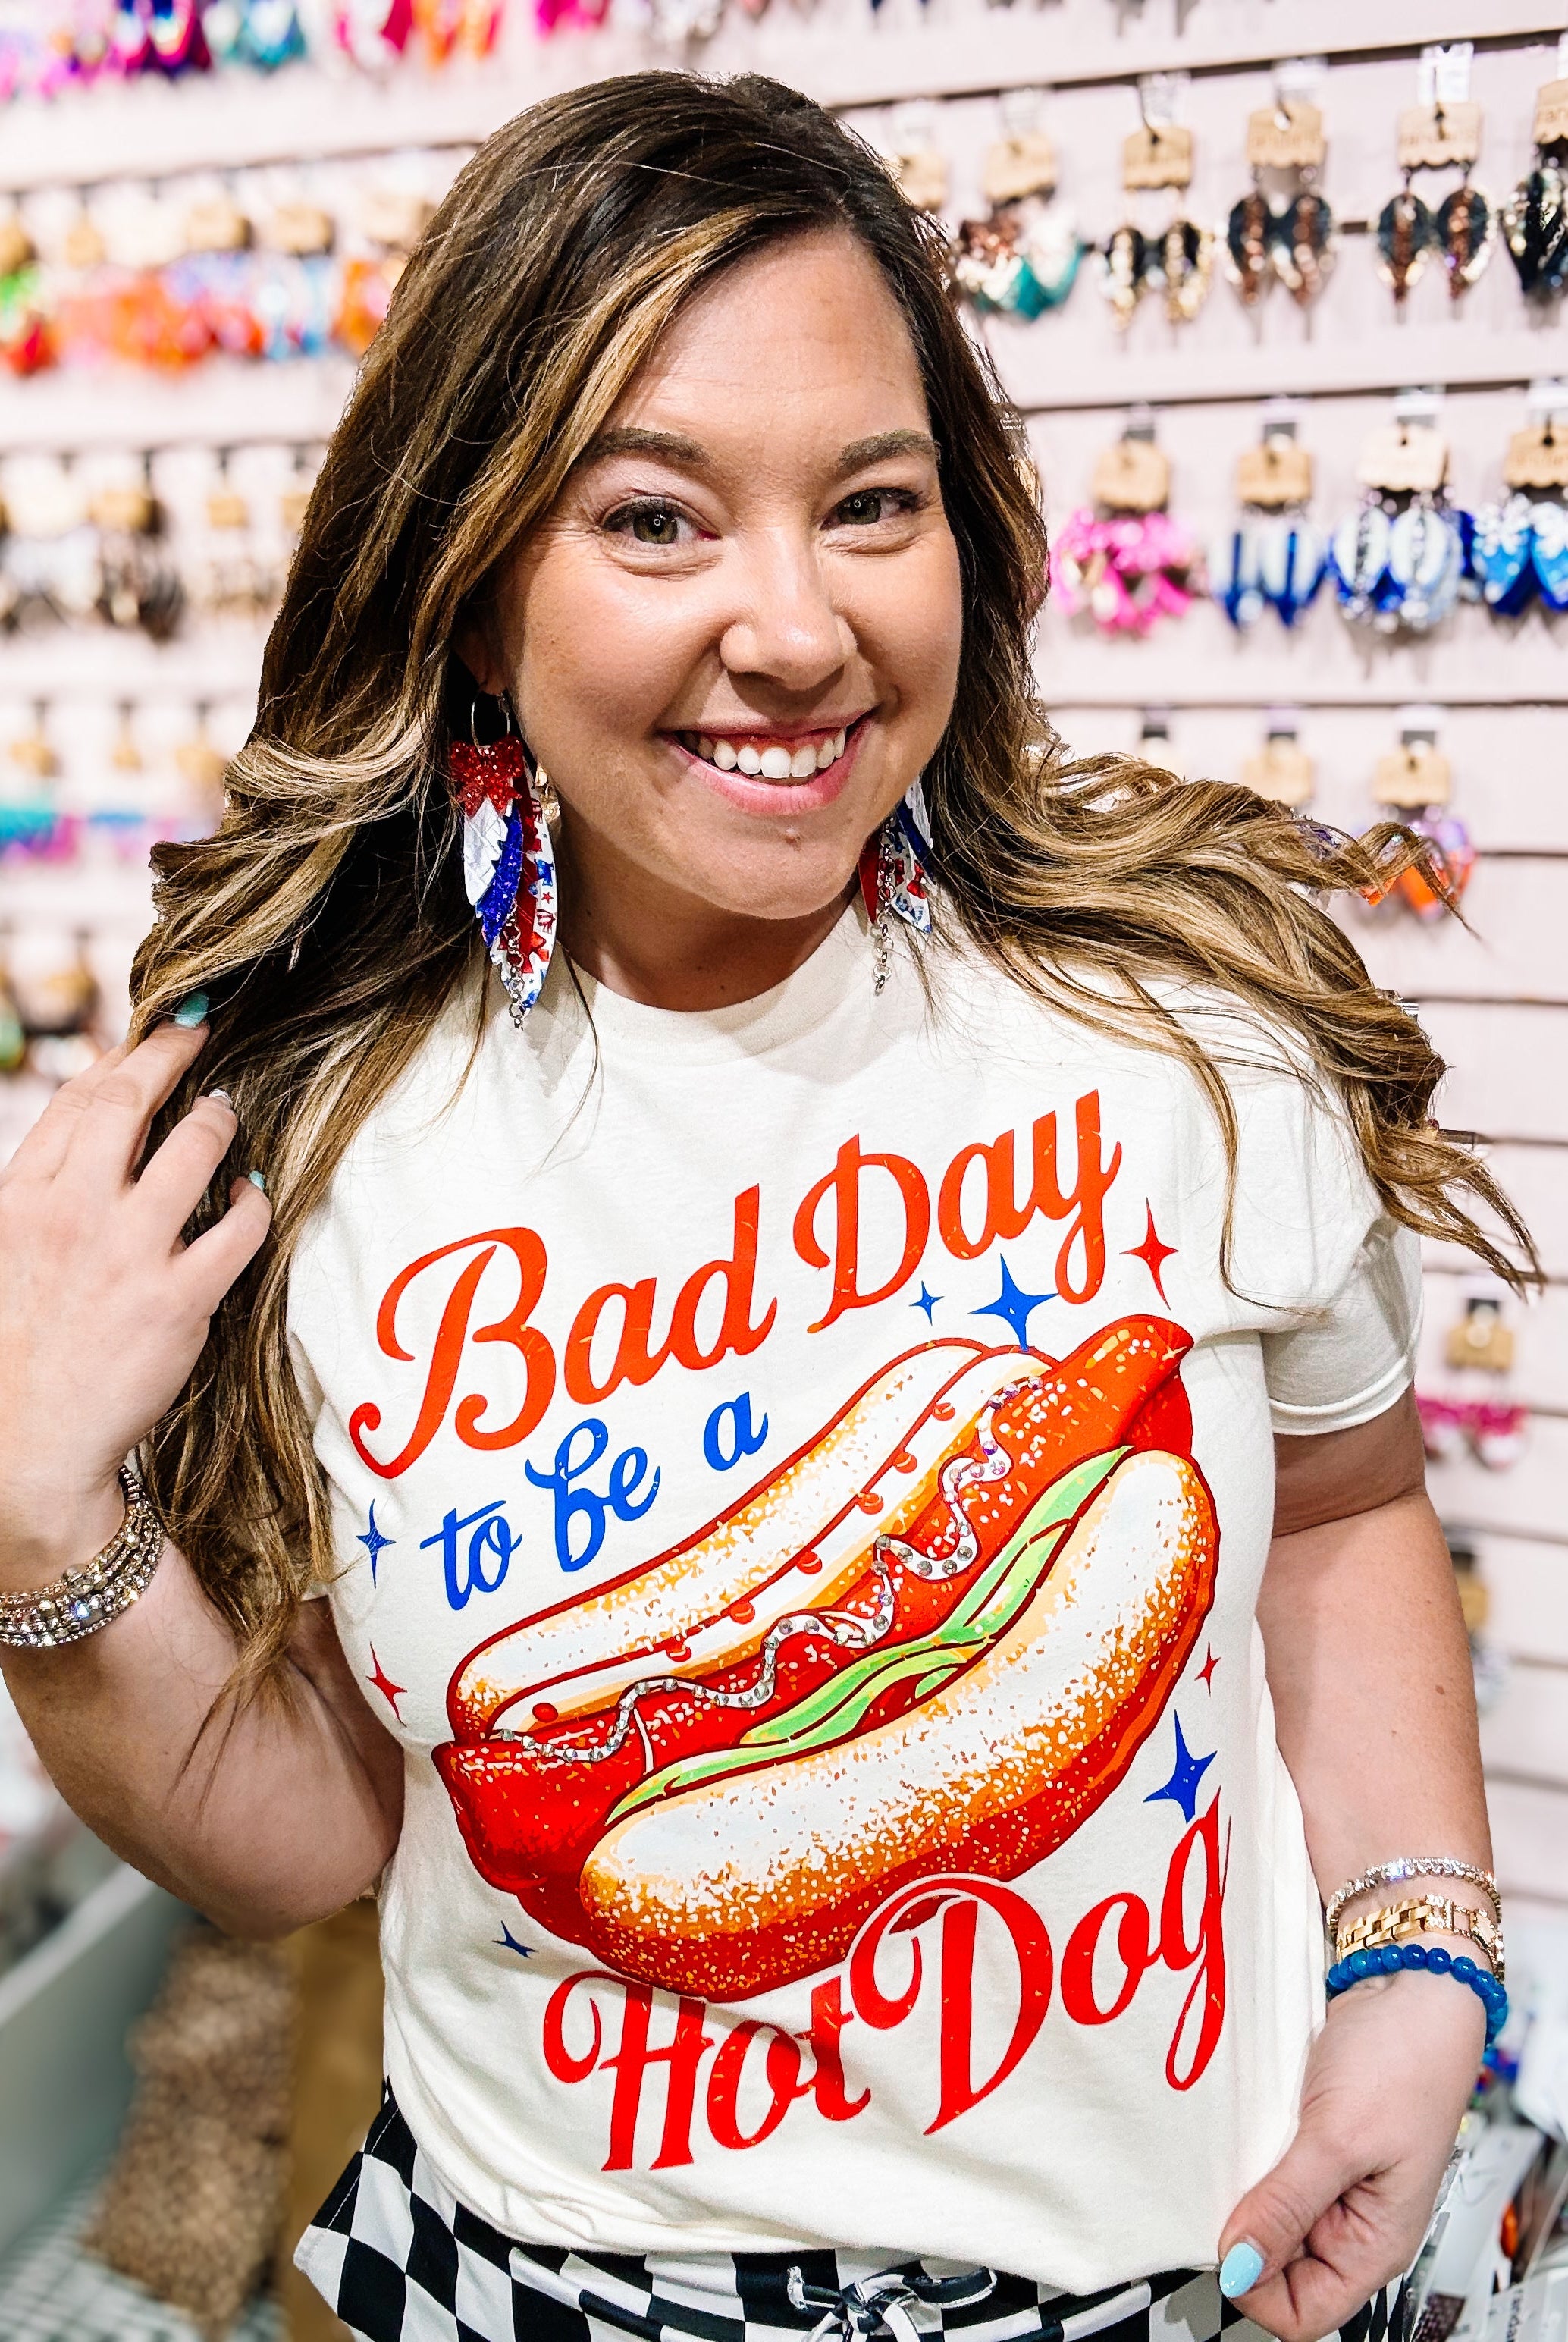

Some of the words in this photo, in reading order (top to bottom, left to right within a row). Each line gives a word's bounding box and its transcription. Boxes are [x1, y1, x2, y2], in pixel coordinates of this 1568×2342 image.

[348, 1183, 777, 1480] Bad
[793, 1088, 1123, 1335] Day
[419, 1499, 523, 1612] to
[525, 1417, 661, 1574] be
[702, 1391, 769, 1472] a
[543, 1970, 872, 2172] Hot
[850, 1785, 1231, 2136] Dog
